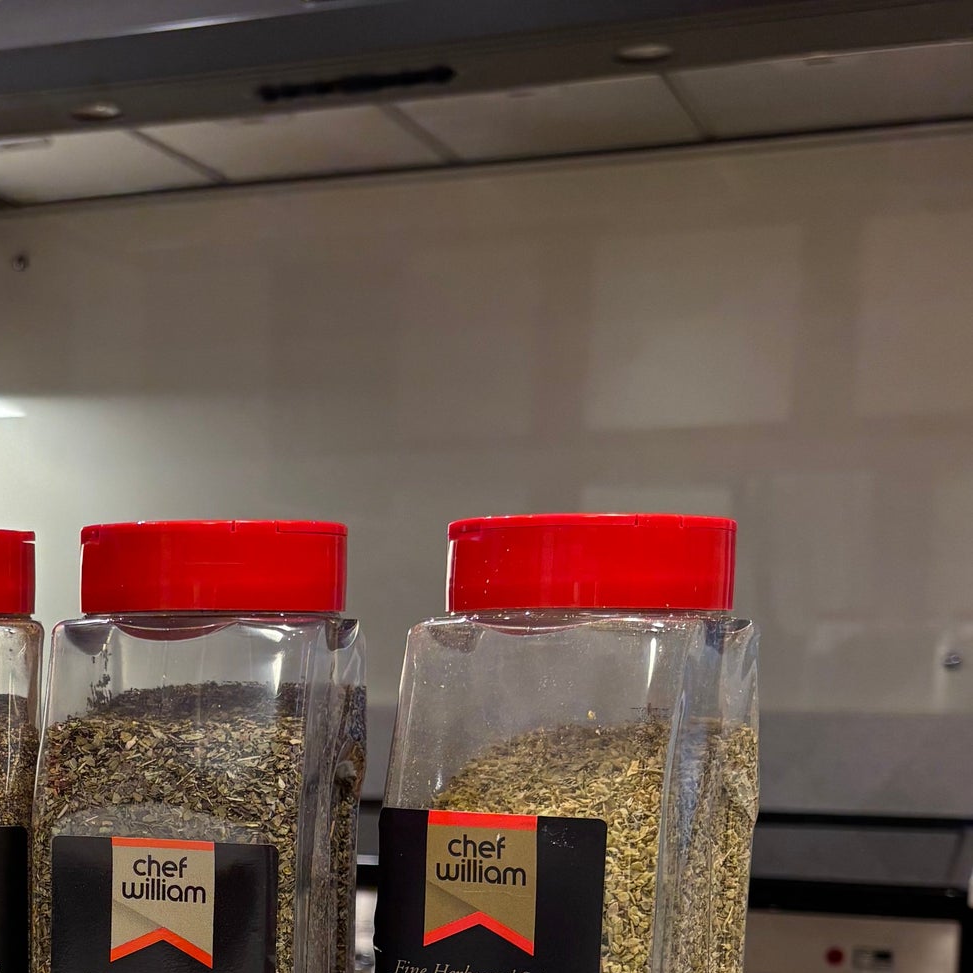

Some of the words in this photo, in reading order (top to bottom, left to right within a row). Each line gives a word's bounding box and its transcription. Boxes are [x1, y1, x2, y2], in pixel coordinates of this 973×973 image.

[447, 834, 506, 859] chef
[133, 855, 187, 879] chef
[436, 859, 526, 886] william
[122, 878, 206, 904] william
